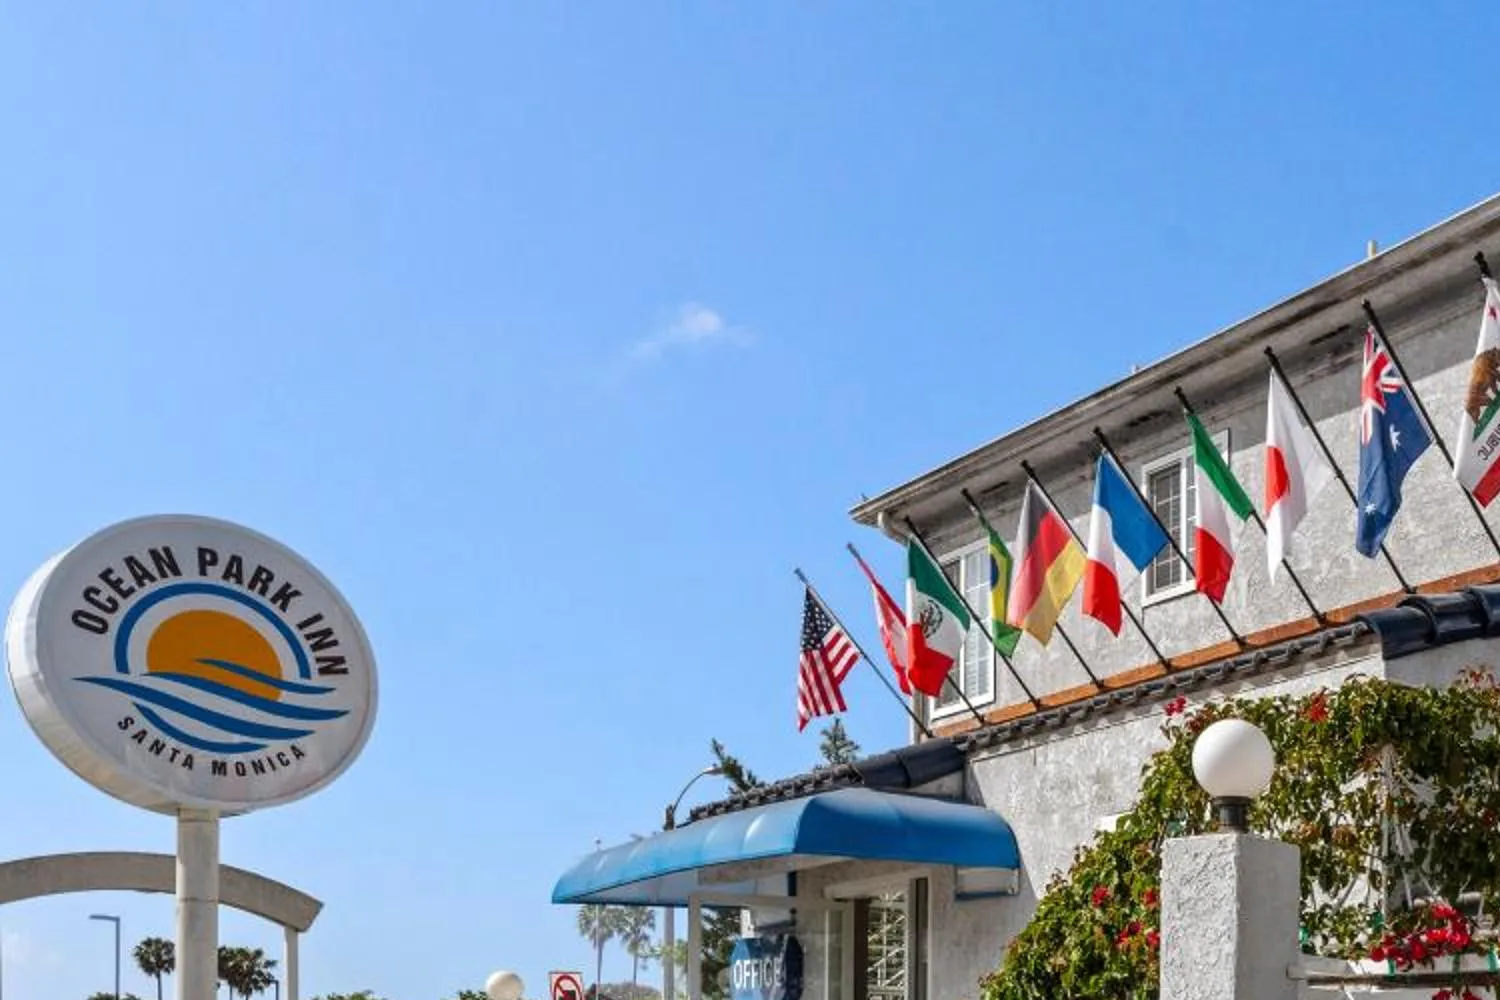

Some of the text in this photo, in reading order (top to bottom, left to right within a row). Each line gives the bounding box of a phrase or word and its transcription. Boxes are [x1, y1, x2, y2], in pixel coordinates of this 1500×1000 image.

[71, 546, 349, 678] OCEAN PARK INN
[117, 715, 306, 778] SANTA MONICA
[733, 956, 783, 990] OFFICE
